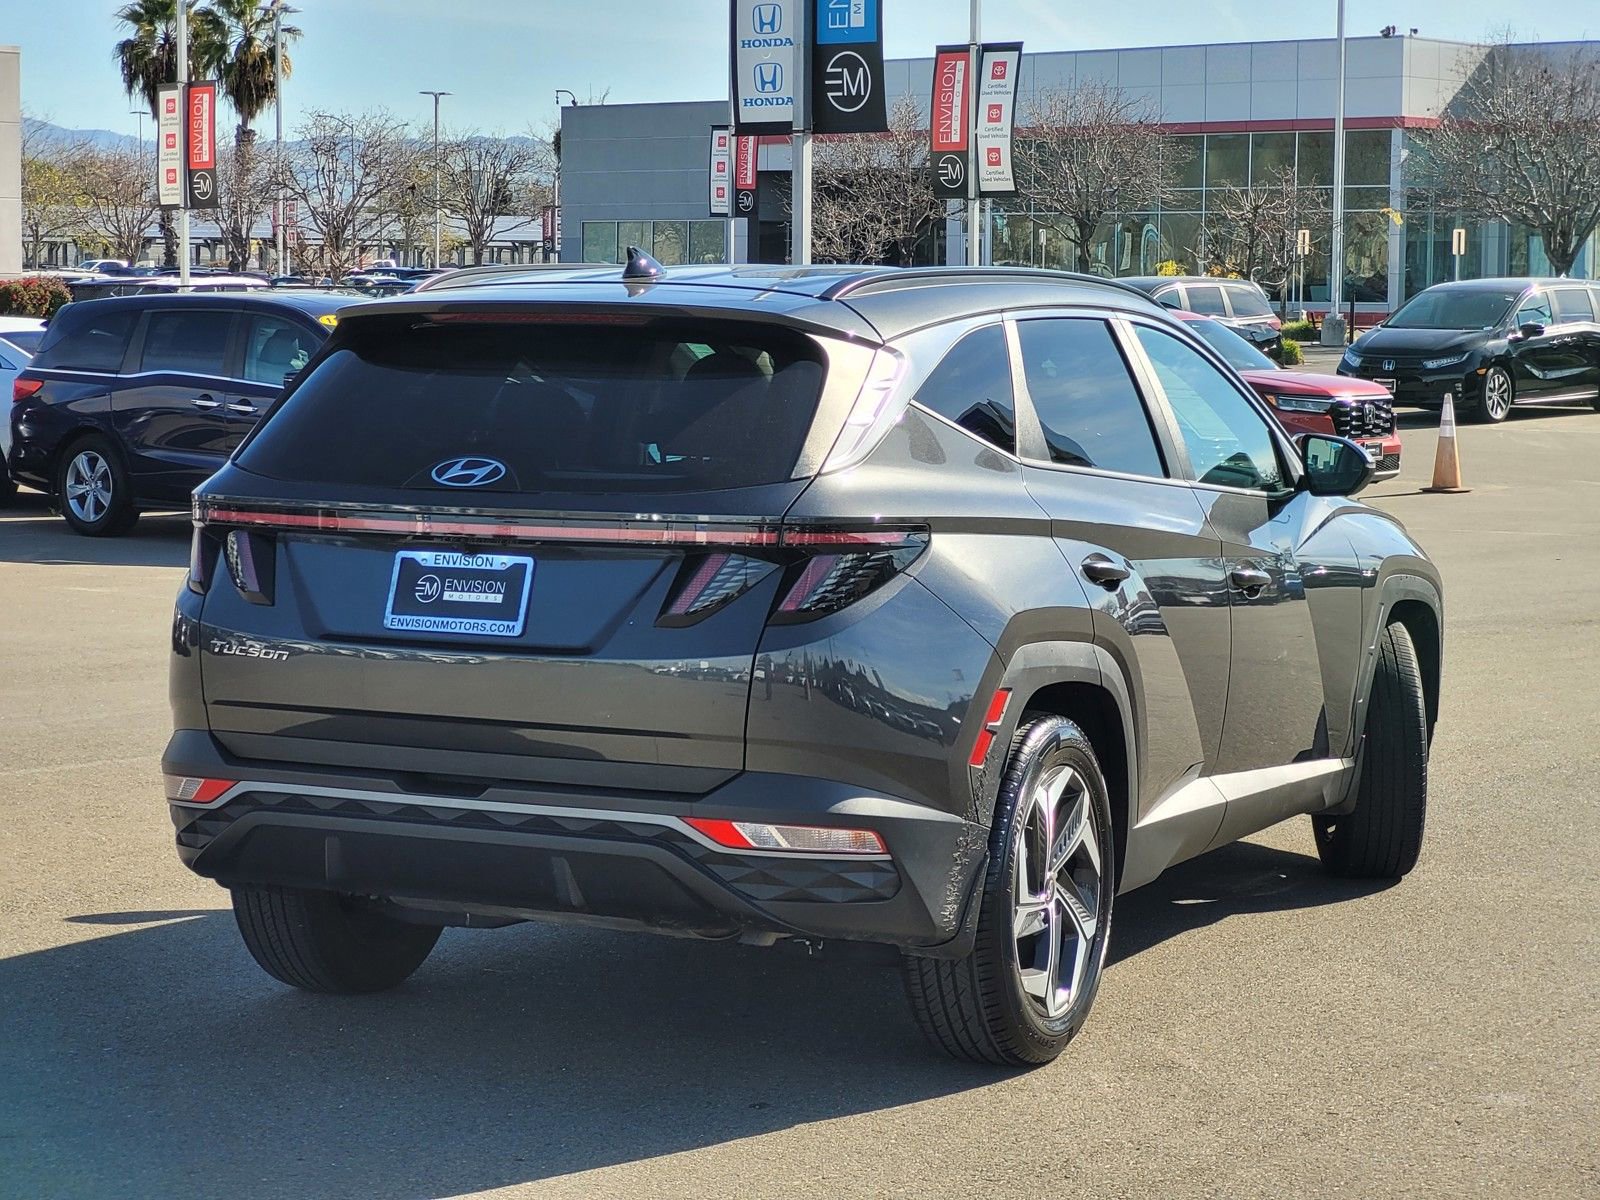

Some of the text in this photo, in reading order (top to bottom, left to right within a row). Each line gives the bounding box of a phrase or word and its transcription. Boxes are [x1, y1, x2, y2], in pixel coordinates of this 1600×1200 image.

[741, 38, 793, 49] HONDA
[743, 96, 793, 107] HONDA
[939, 61, 956, 143] ENVISION
[953, 68, 963, 136] MOTORS
[193, 94, 203, 162] ENVISION
[740, 136, 749, 184] ENVISION
[434, 554, 494, 568] ENVISION
[444, 579, 507, 593] ENVISION
[390, 617, 516, 634] ENVISIONMOTORS.COM
[210, 639, 290, 660] TUCSON
